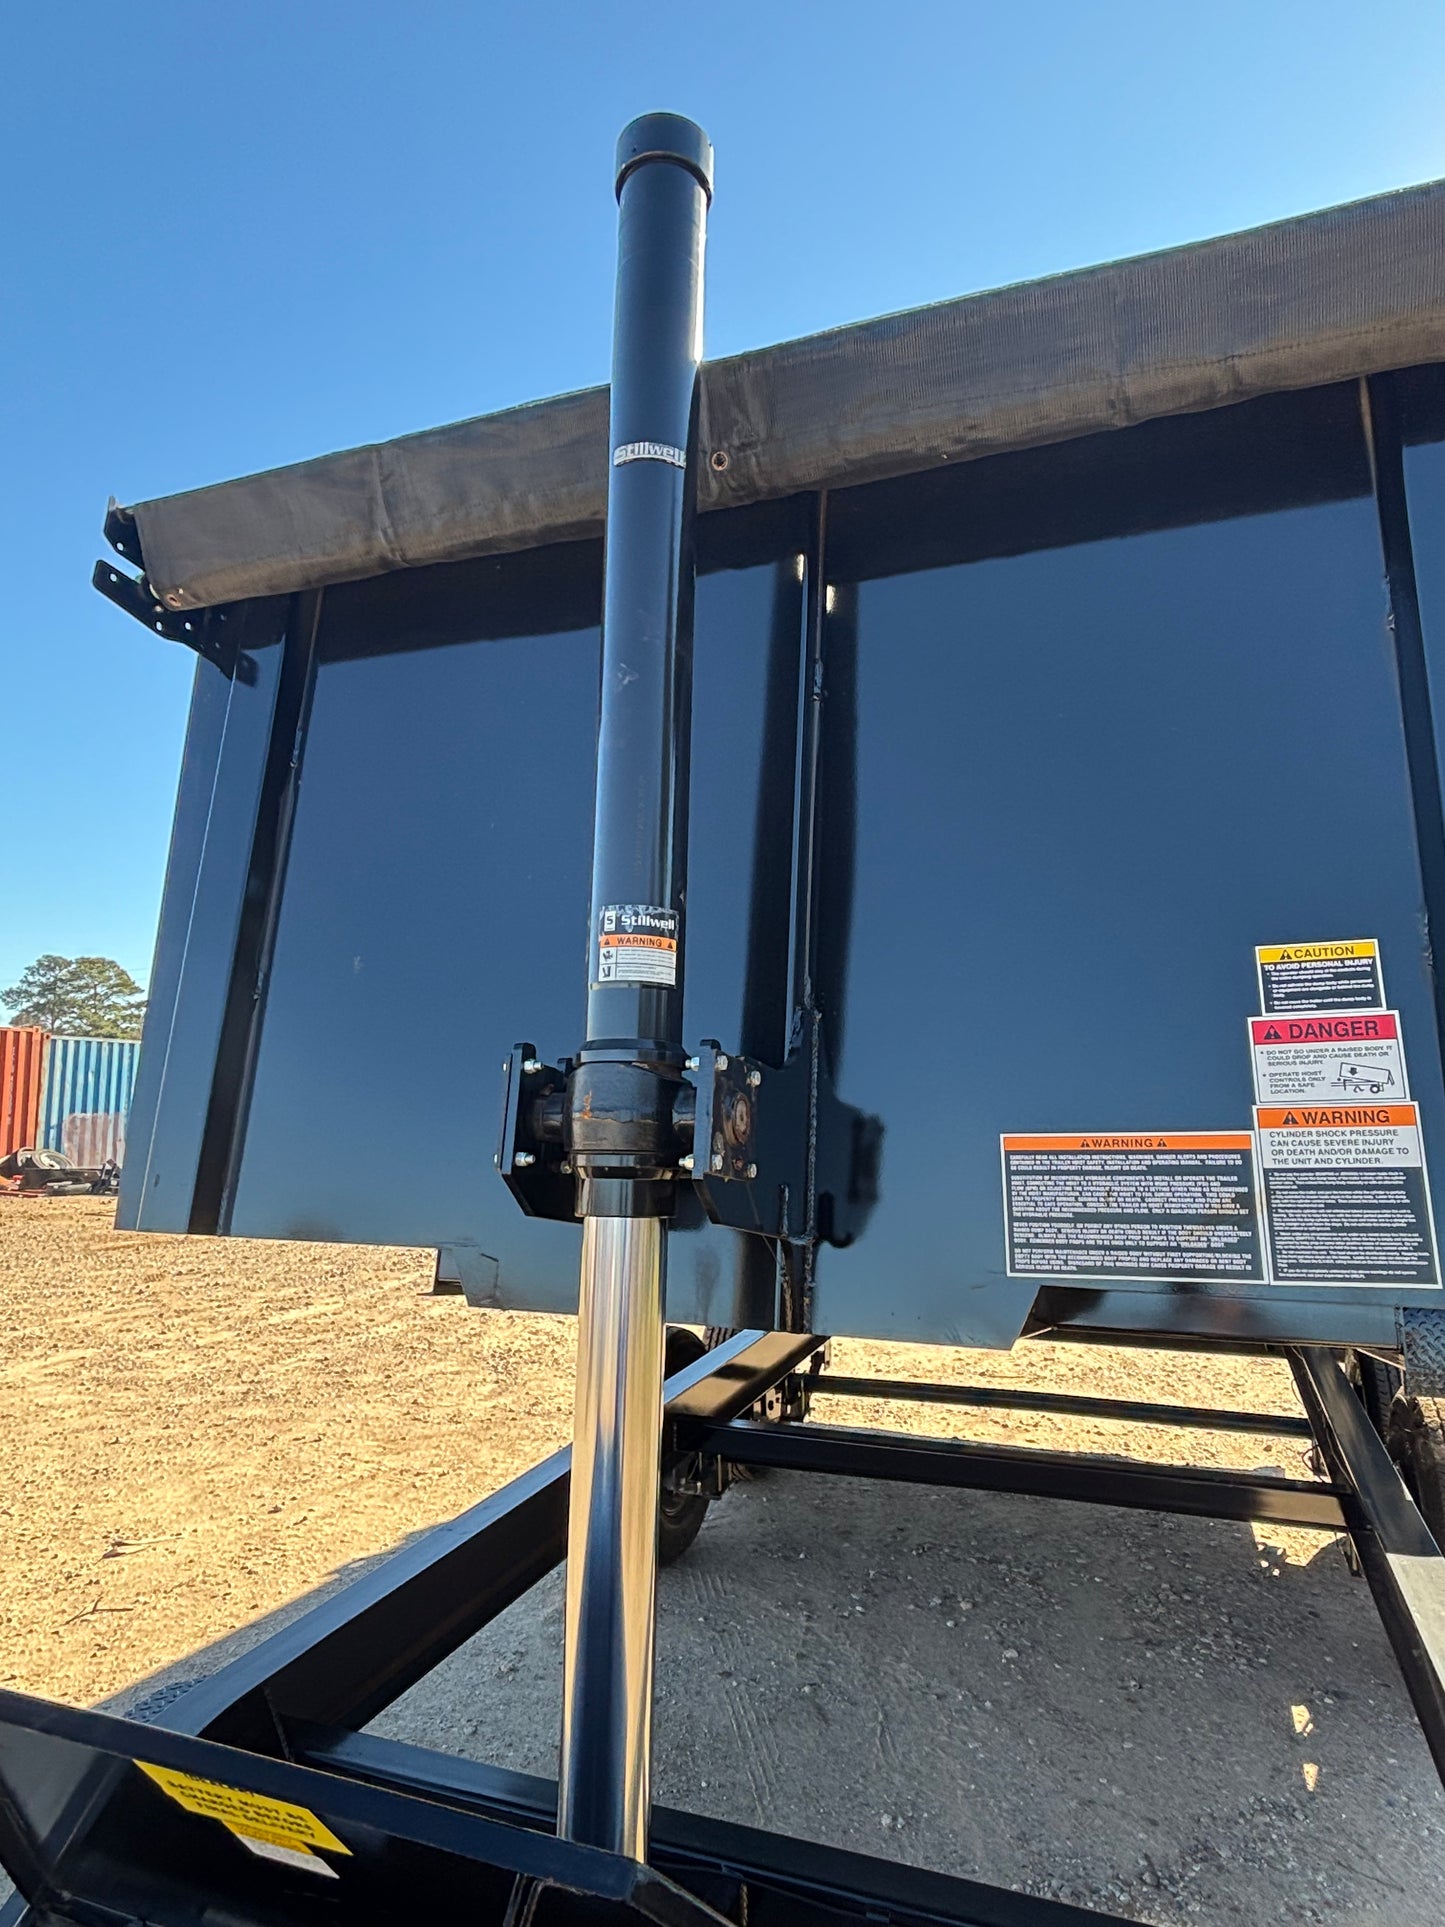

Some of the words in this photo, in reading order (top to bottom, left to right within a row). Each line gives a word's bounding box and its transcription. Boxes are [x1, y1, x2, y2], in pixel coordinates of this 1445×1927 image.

[621, 915, 674, 930] Stillwell
[617, 937, 662, 947] WARNING
[1294, 946, 1354, 959] CAUTION
[1301, 961, 1343, 969] PERSONAL
[1345, 958, 1373, 966] INJURY
[1289, 1020, 1379, 1039] DANGER
[1302, 1110, 1390, 1124] WARNING
[1350, 1129, 1399, 1137] PRESSURE
[1092, 1138, 1153, 1148] WARNING
